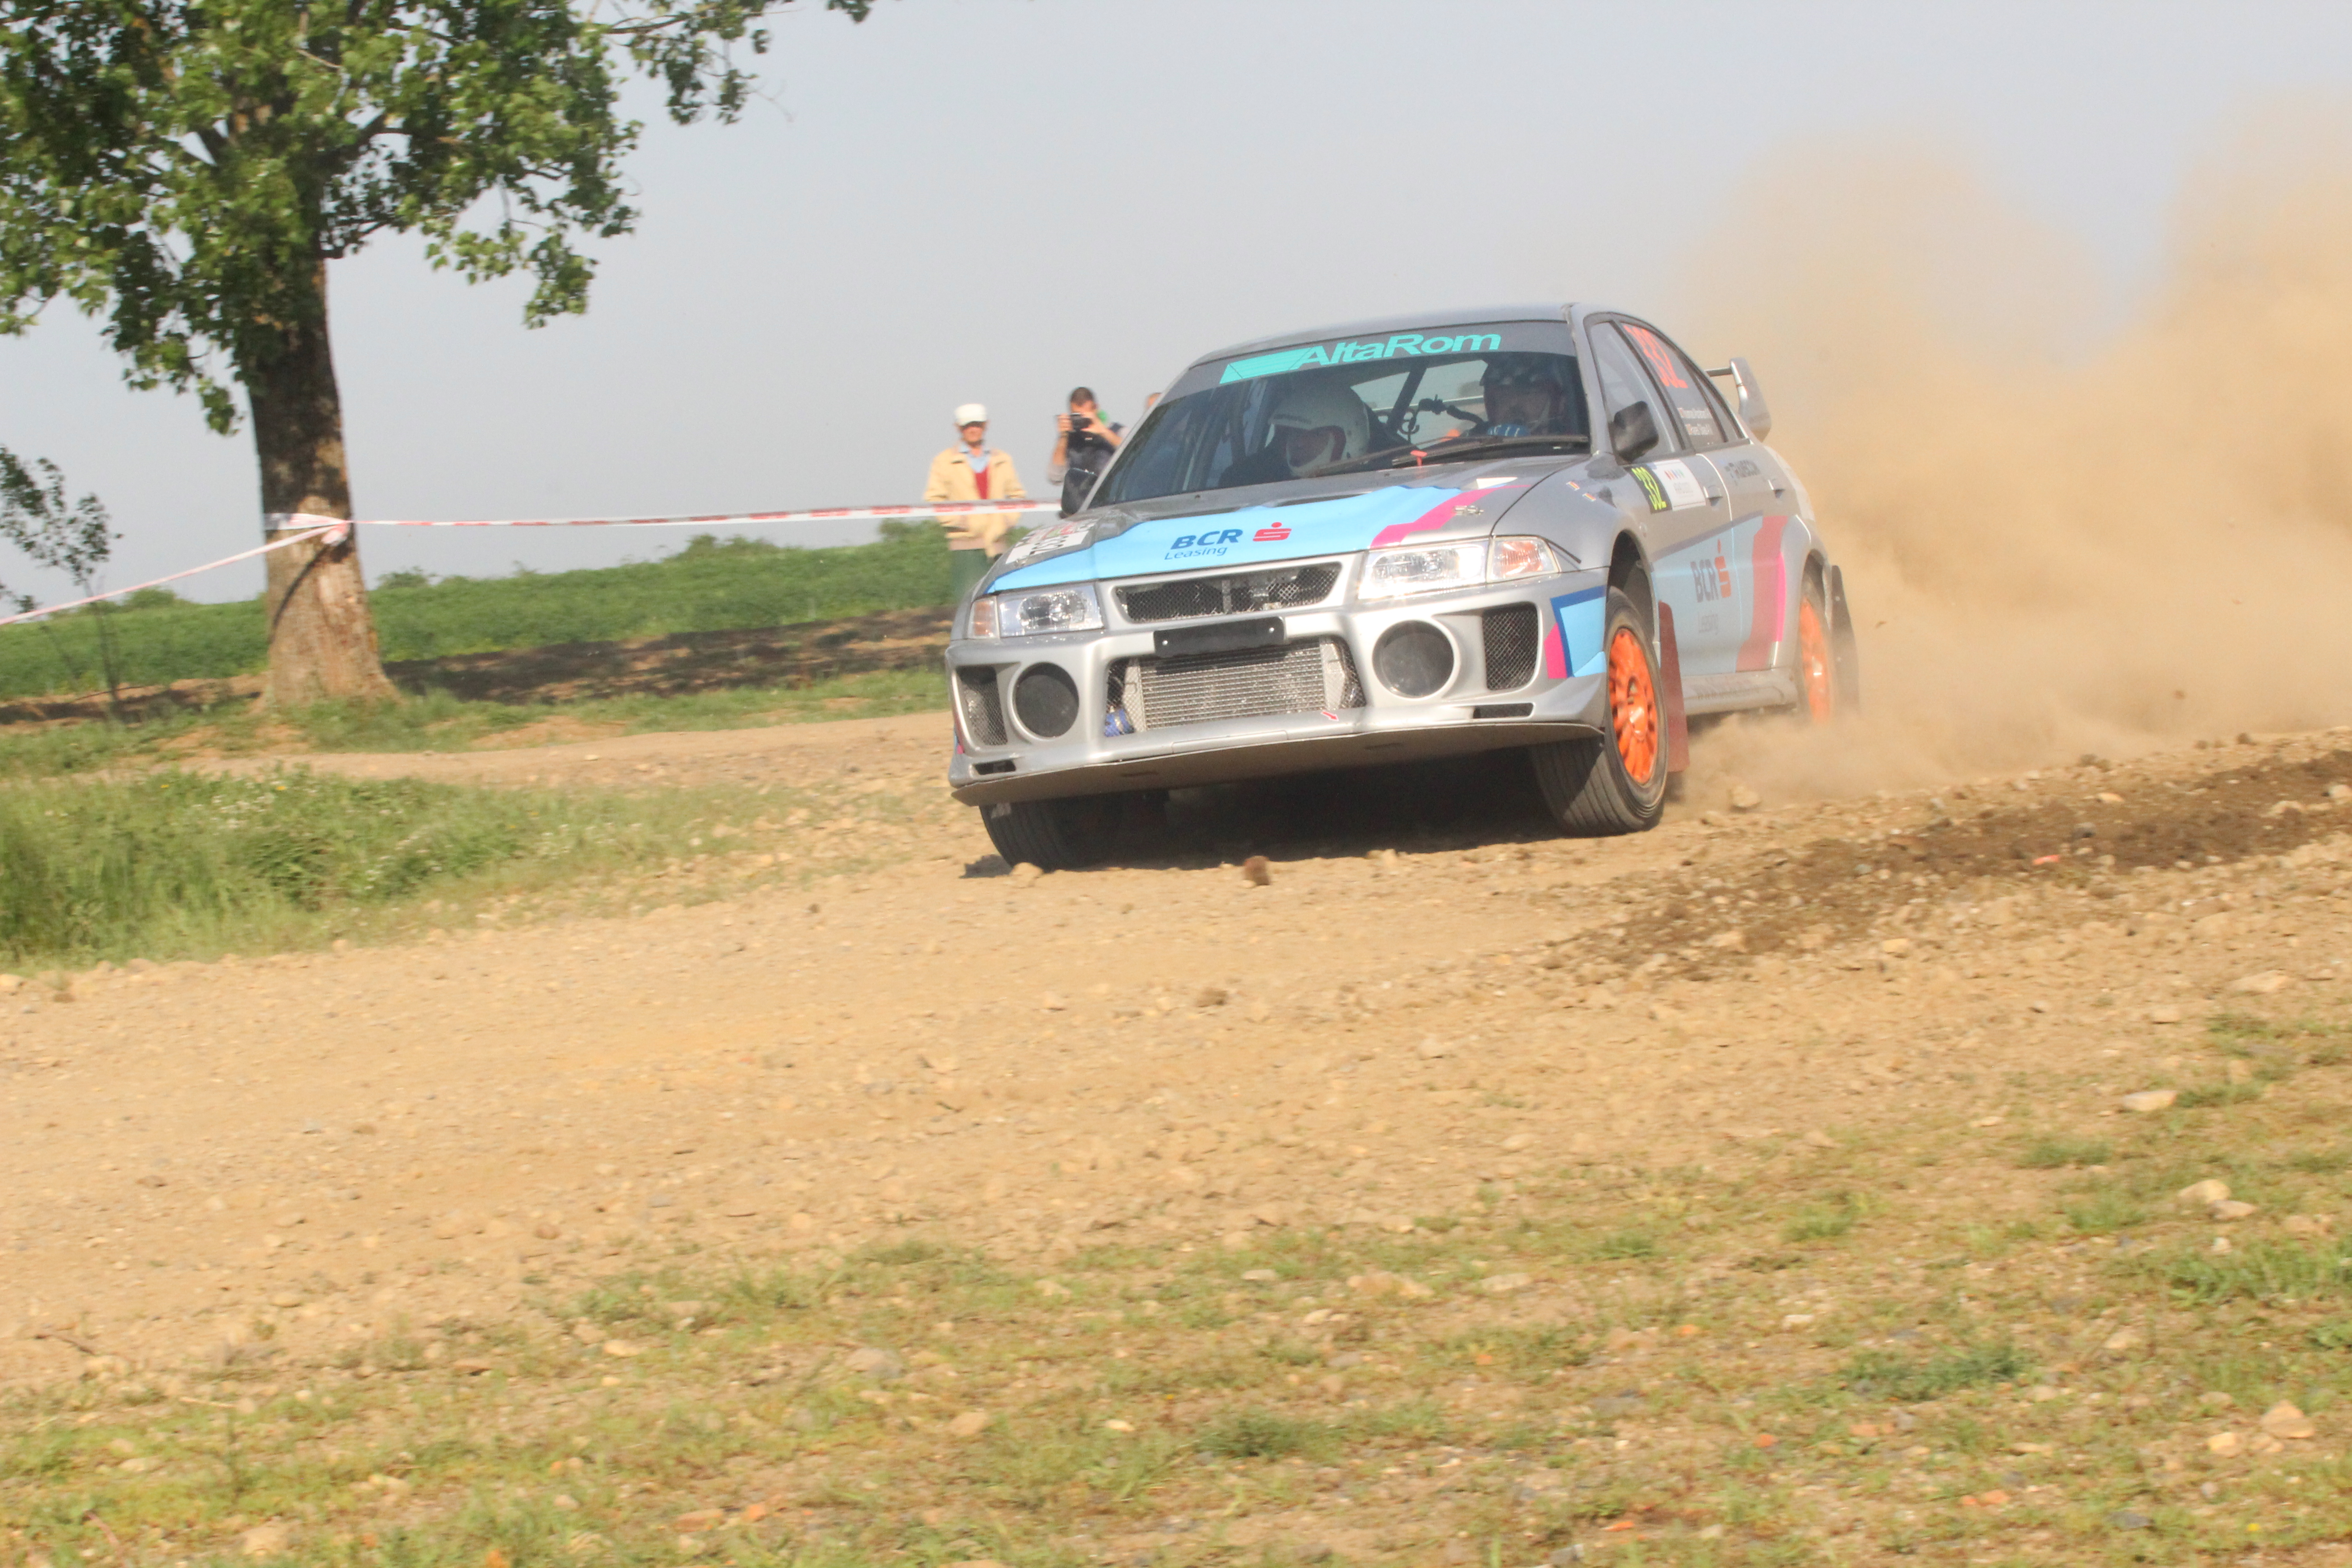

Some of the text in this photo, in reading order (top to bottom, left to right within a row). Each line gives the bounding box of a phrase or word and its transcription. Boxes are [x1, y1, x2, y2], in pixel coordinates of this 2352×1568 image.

[1288, 333, 1501, 371] AltaRom
[1631, 466, 1667, 510] 332
[1164, 547, 1228, 560] Leasing
[1171, 529, 1243, 550] BCR
